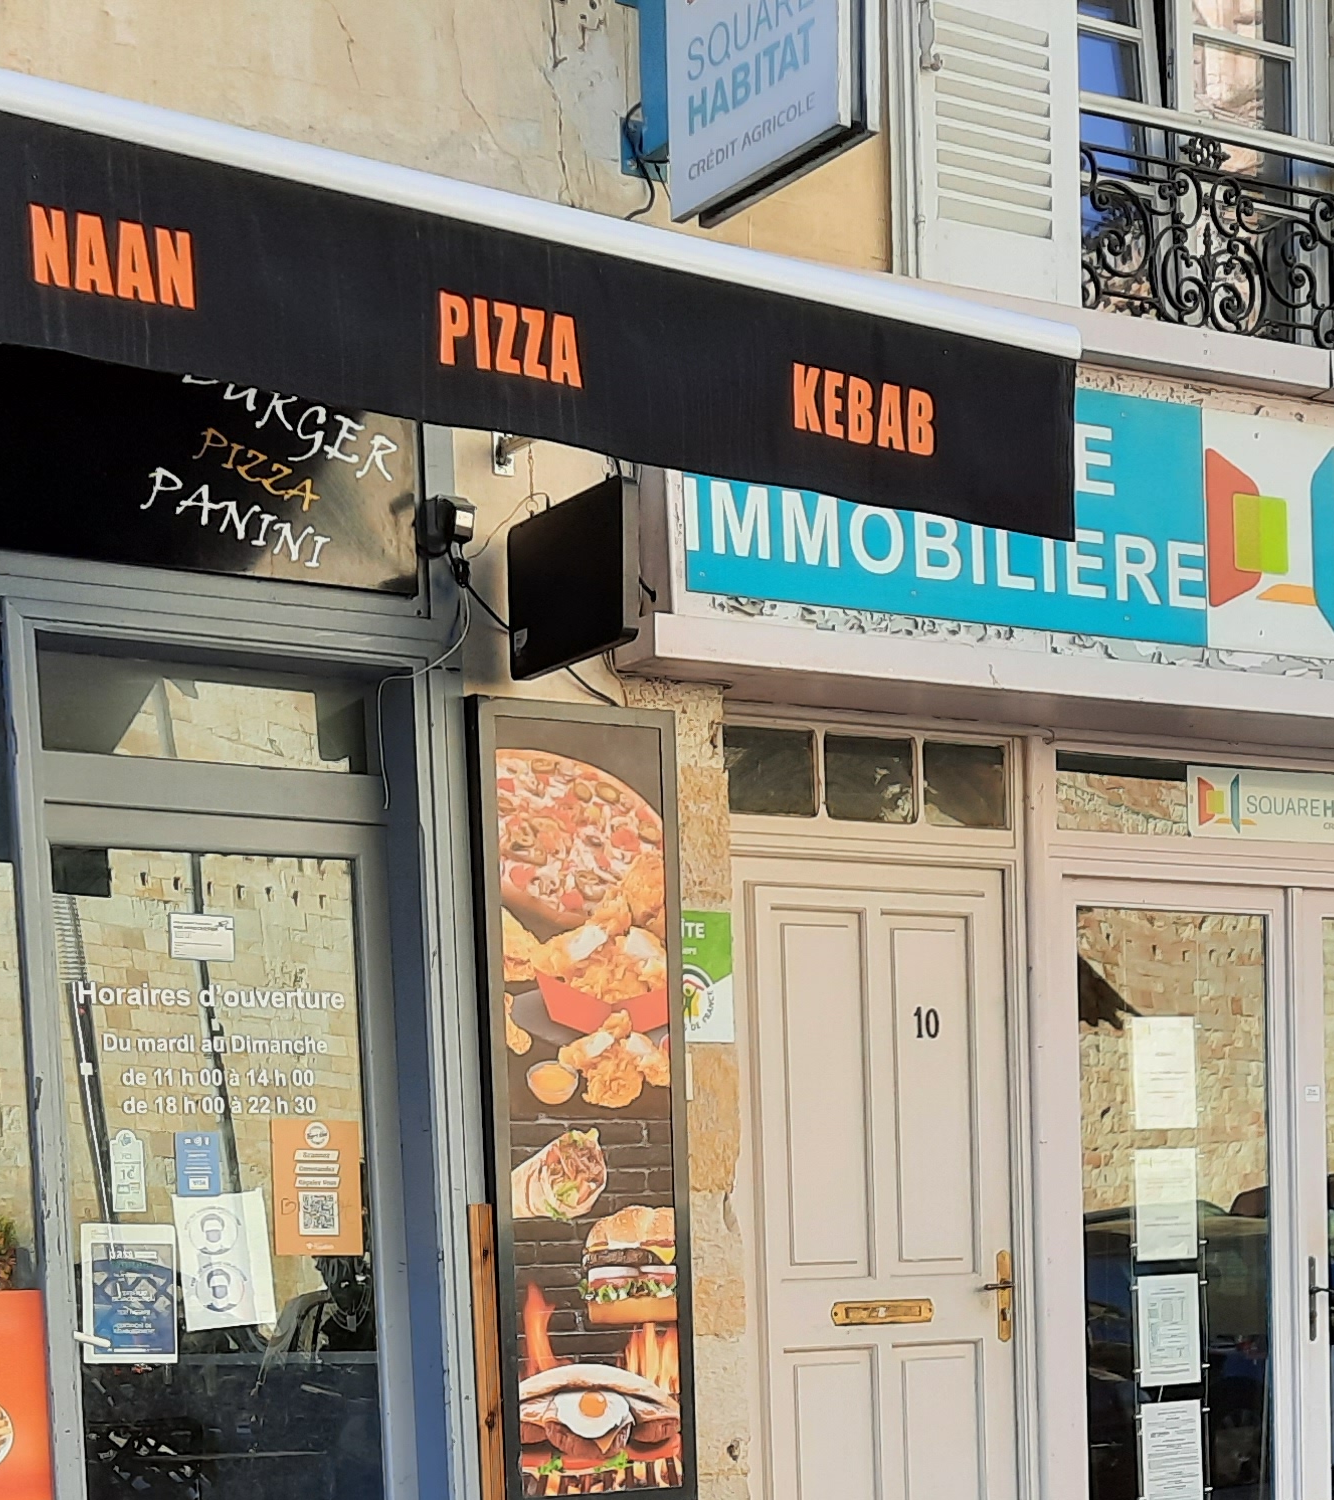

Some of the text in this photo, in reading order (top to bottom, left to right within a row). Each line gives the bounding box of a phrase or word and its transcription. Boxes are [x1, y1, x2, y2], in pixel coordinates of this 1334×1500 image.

[688, 17, 816, 137] HABITAT
[687, 91, 817, 182] CRÉDIT AGRICOLE
[28, 202, 196, 311] NAAN
[438, 288, 584, 389] PIZZA
[791, 361, 936, 456] KEBAB
[192, 427, 321, 512] PIZZA
[140, 466, 331, 568] PANINI
[78, 981, 346, 1009] Horaires d'ouverture
[912, 1006, 940, 1039] 10
[102, 1033, 328, 1054] Du mardi au Dimanche
[122, 1068, 314, 1087] de 11 h 00 à 14 h 00
[123, 1096, 317, 1114] de 18 h 00 à 22 h 30
